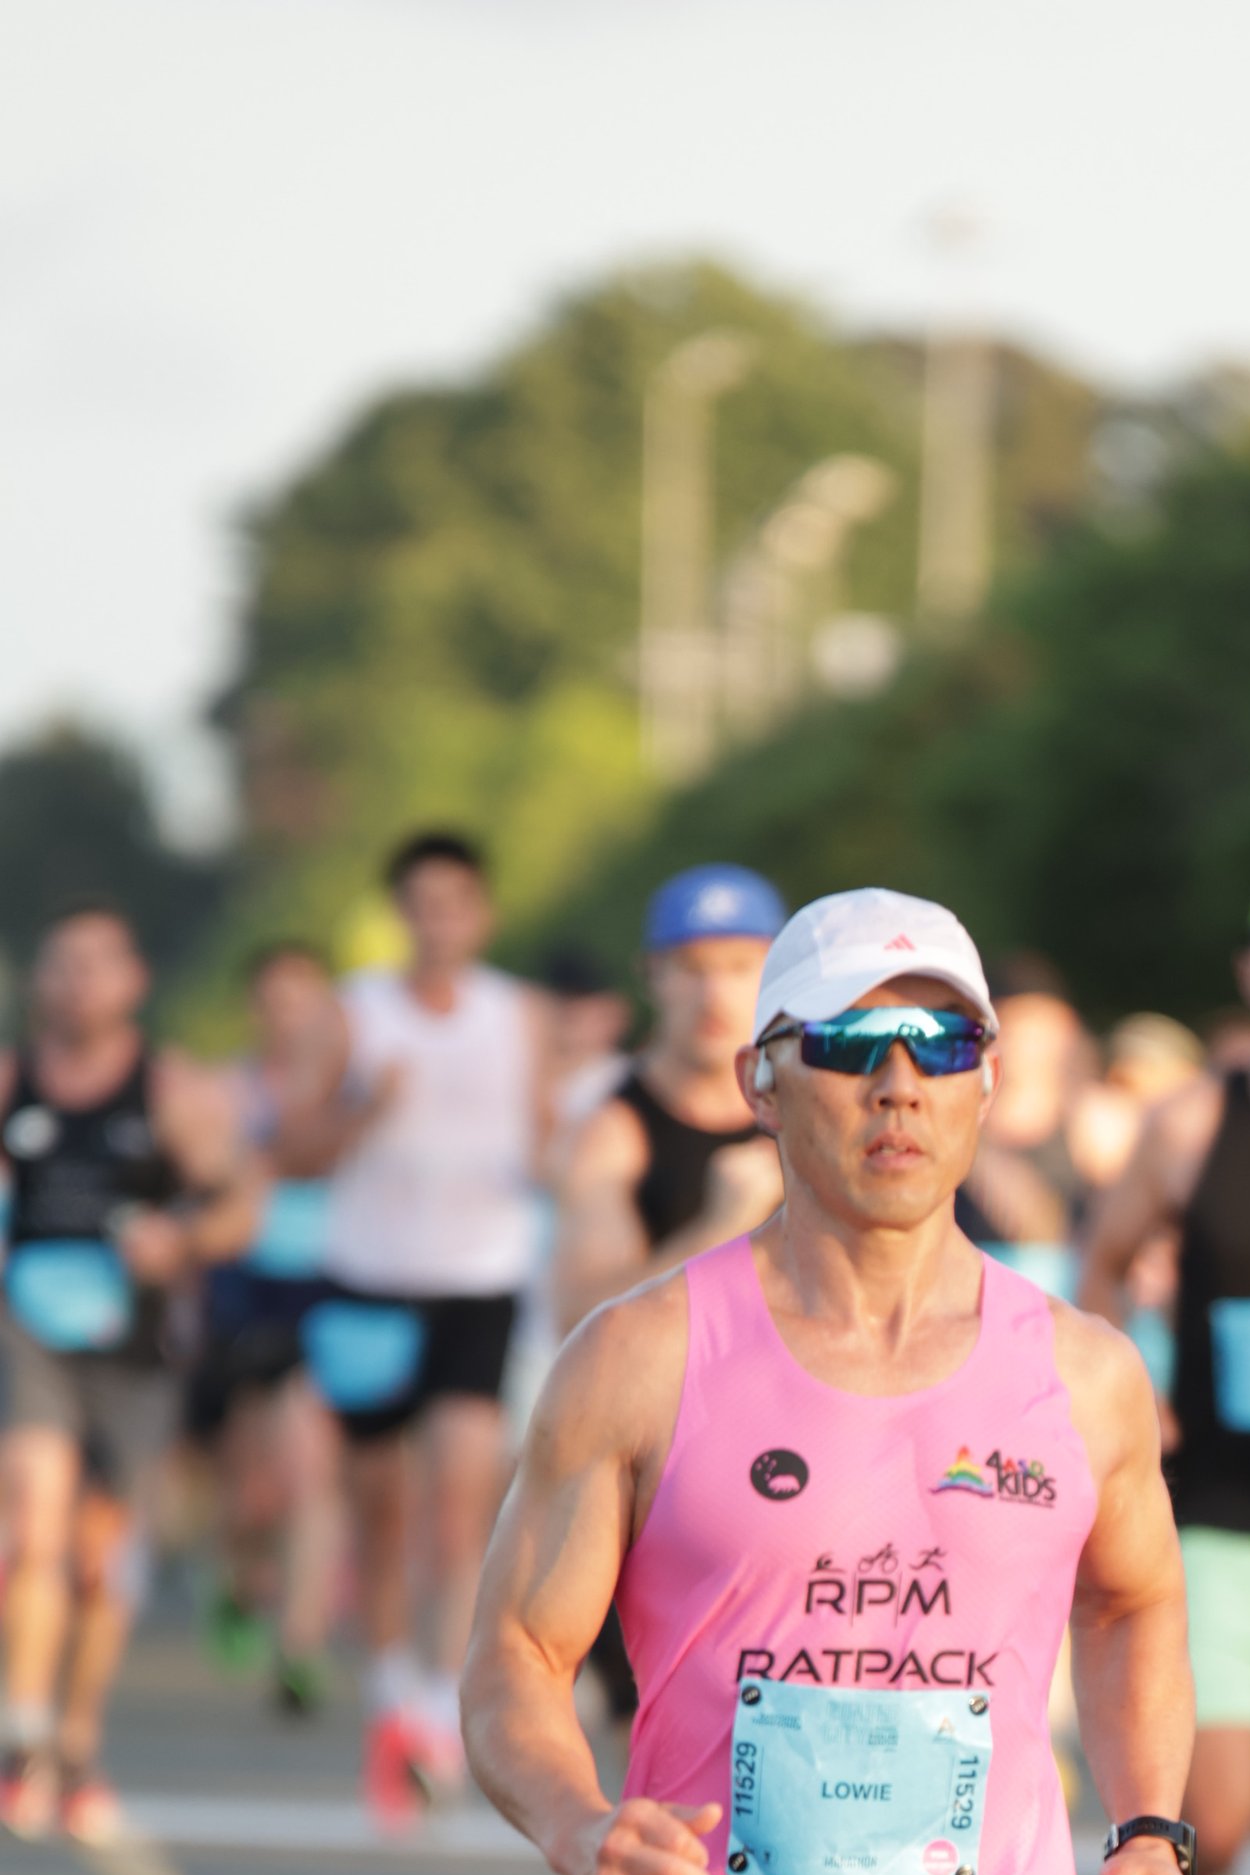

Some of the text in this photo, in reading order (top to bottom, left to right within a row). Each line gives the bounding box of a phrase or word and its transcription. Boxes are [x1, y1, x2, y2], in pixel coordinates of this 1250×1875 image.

[735, 1648, 999, 1687] RATPACK
[735, 1742, 757, 1817] 11529
[821, 1781, 893, 1801] LOWIE
[951, 1755, 979, 1830] 11529
